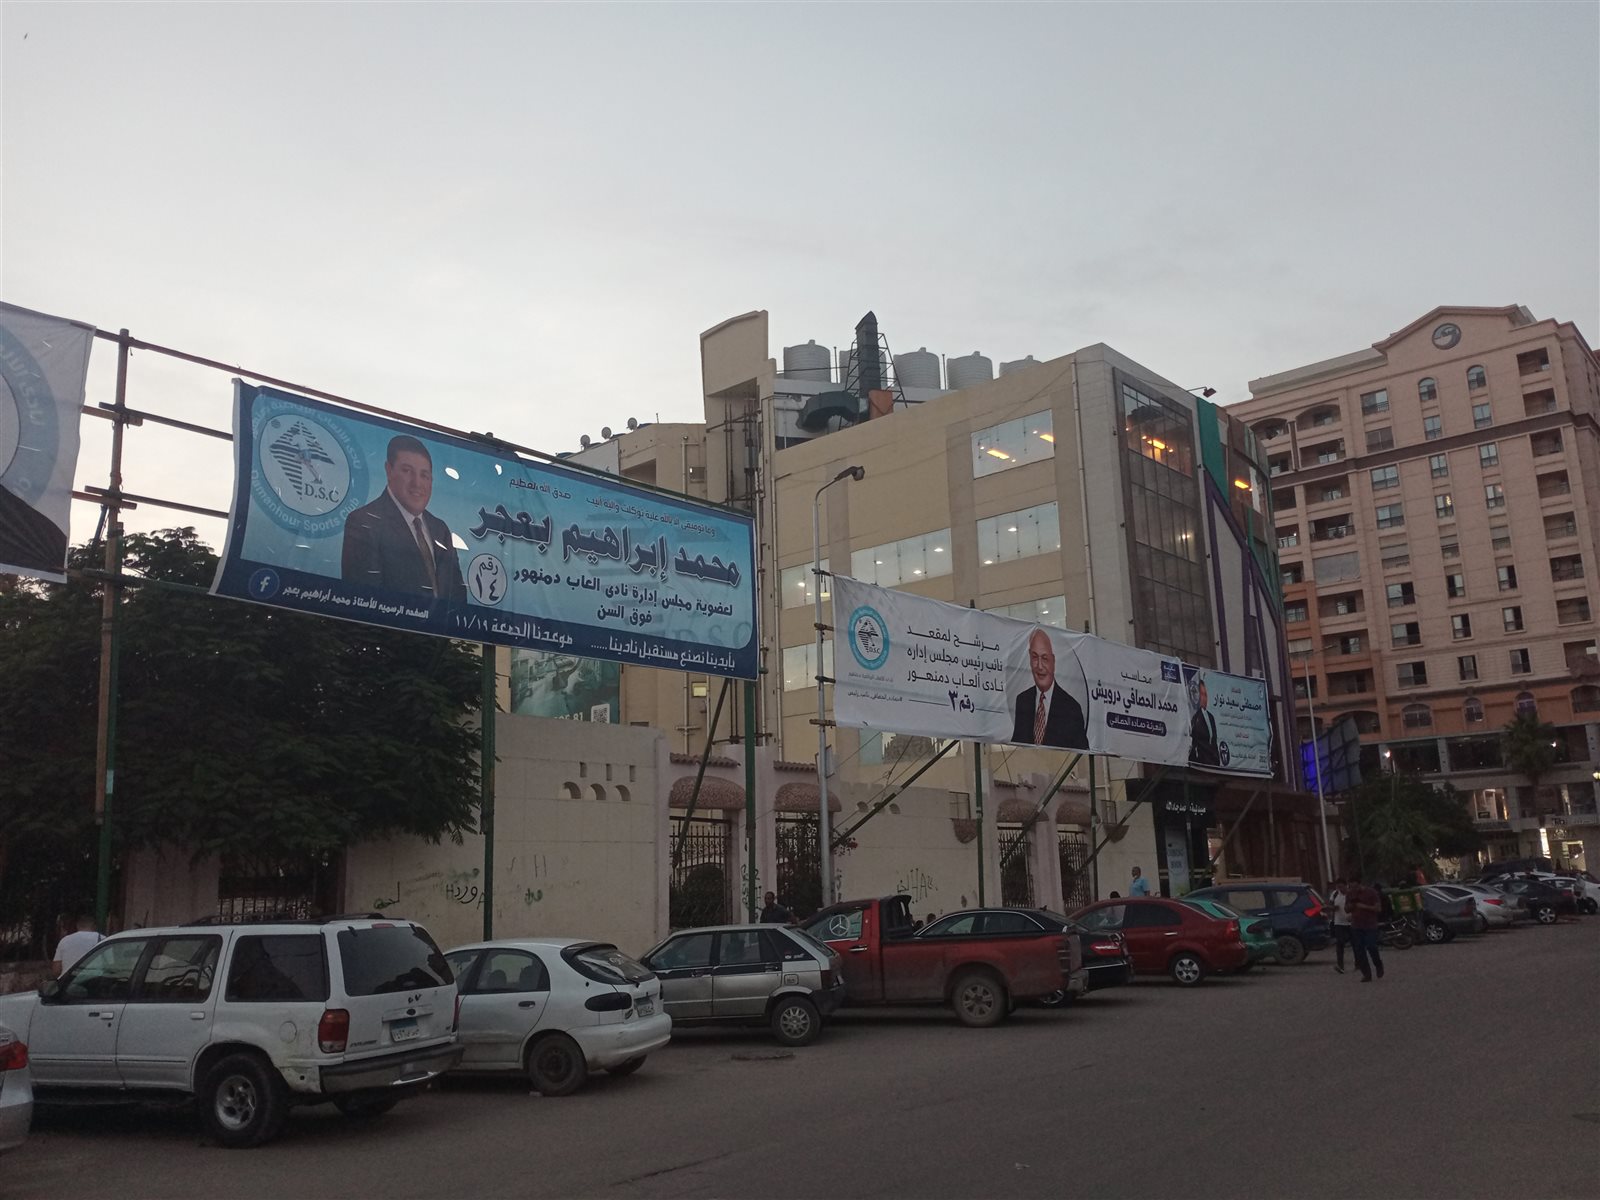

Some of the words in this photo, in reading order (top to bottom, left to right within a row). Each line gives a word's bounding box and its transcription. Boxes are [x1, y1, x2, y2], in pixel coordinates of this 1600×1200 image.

[303, 483, 340, 503] D.S.C
[539, 481, 551, 493] الله
[551, 487, 572, 499] صدق
[303, 517, 341, 534] Sports
[339, 497, 360, 520] Club
[561, 524, 669, 582] إبراهيم
[478, 557, 499, 575] رقم
[513, 567, 561, 584] دمنهور
[674, 545, 742, 587] محمد
[475, 573, 500, 601] ١٤
[566, 574, 600, 591] العاب
[332, 593, 351, 605] محمد
[632, 585, 657, 607] إدارة
[661, 594, 692, 612] مجلس
[597, 603, 624, 621] السن
[629, 608, 653, 627] فوق
[696, 599, 733, 617] لعضوية
[491, 617, 531, 640] الجمعة
[532, 623, 573, 646] موعدنا
[907, 625, 951, 642] لمقعد
[640, 640, 679, 661] مستقبل
[953, 634, 1000, 652] مرشح
[680, 643, 706, 668] نصنع
[706, 646, 736, 672] بأيدينا
[907, 643, 928, 664] إداره
[929, 648, 959, 667] مجلس
[961, 655, 984, 672] رئيس
[986, 658, 1003, 673] نائب
[907, 669, 950, 684] دمنهور
[951, 671, 981, 689] ألعاب
[1120, 669, 1152, 684] محاسب
[948, 689, 958, 711] ٣
[1091, 679, 1121, 706] درويش
[1122, 687, 1156, 713] الحصافي
[959, 694, 975, 713] رقم
[1157, 699, 1178, 713] محمد
